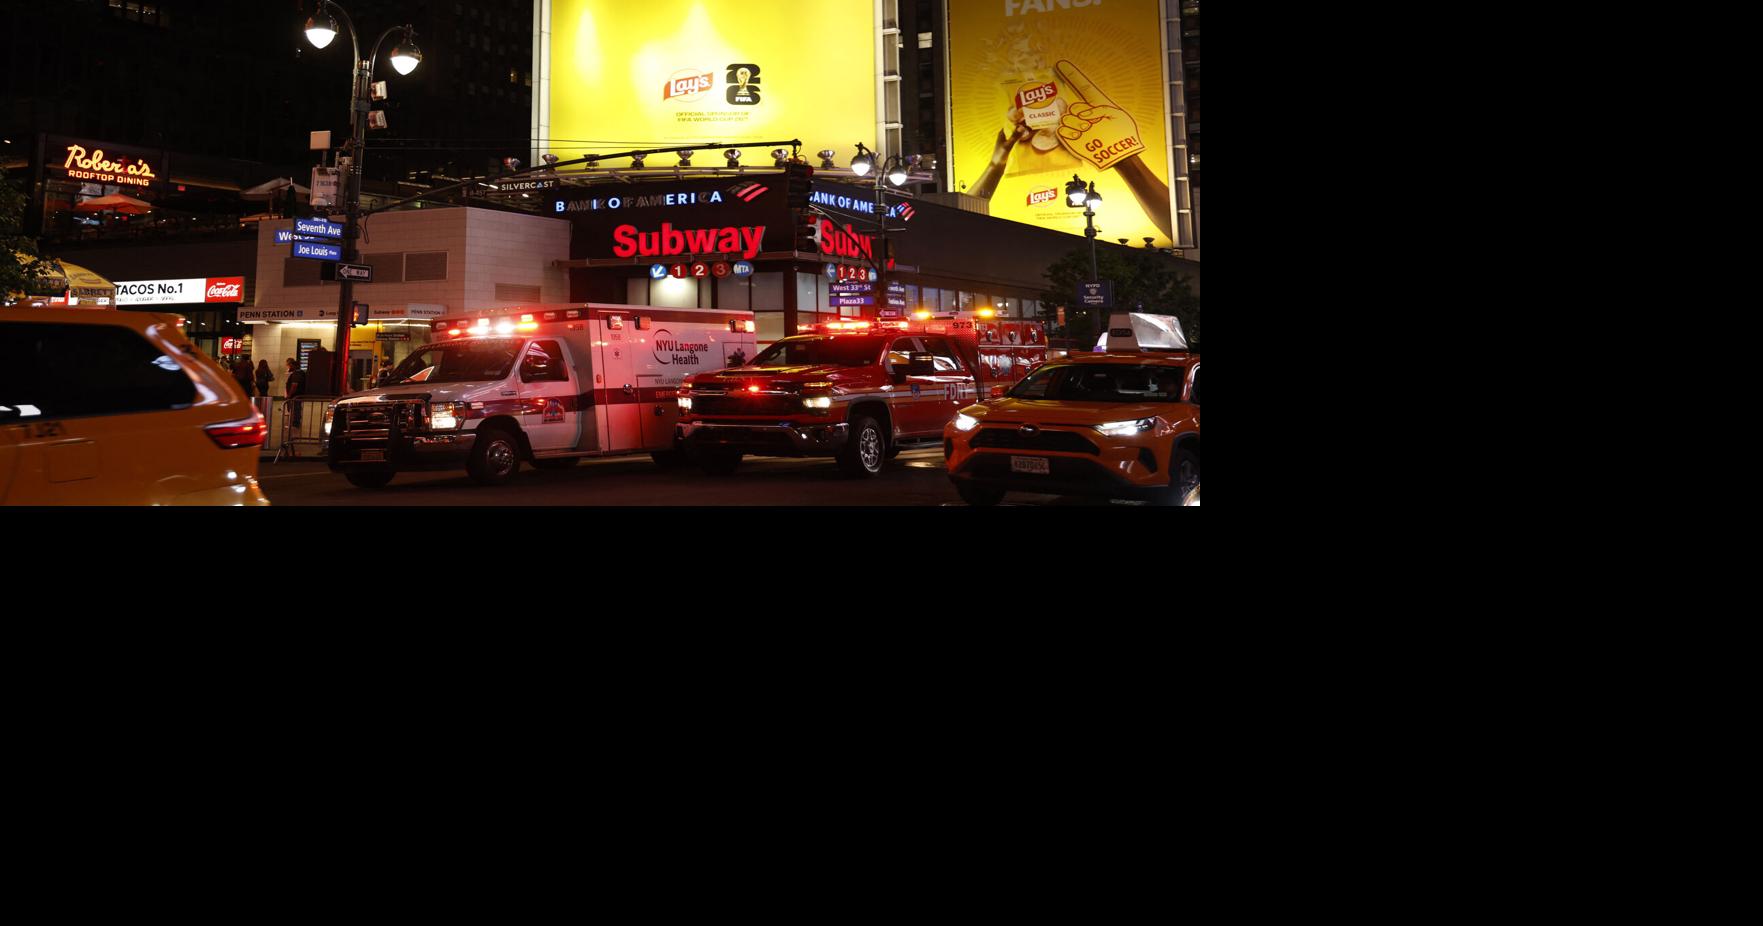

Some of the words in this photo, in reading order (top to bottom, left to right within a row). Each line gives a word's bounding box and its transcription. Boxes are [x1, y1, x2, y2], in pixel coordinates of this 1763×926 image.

[670, 75, 709, 97] Lay's
[1019, 83, 1055, 106] Lay's
[1028, 110, 1057, 120] CLASSIC
[1085, 138, 1103, 153] GO
[1093, 135, 1139, 163] SOCCER!
[64, 144, 155, 178] Robera's
[68, 169, 115, 181] ROOFTOP
[116, 175, 150, 187] DINING
[1030, 190, 1056, 204] Lay's
[808, 191, 836, 206] ANK
[837, 196, 852, 210] OF
[853, 199, 896, 218] AMEA
[297, 221, 327, 235] Seventh
[327, 224, 341, 236] Ave
[612, 222, 766, 260] Subway
[298, 245, 310, 255] Joe
[311, 246, 328, 257] Louis
[116, 284, 155, 296] TACOS
[158, 283, 183, 294] No.1
[832, 284, 849, 292] West
[839, 297, 865, 305] Plaza33
[240, 310, 261, 319] PENN
[262, 310, 295, 318] STATION
[952, 321, 972, 329] 973
[656, 340, 674, 352] NYU
[675, 340, 708, 354] Langone
[671, 353, 700, 365] Health
